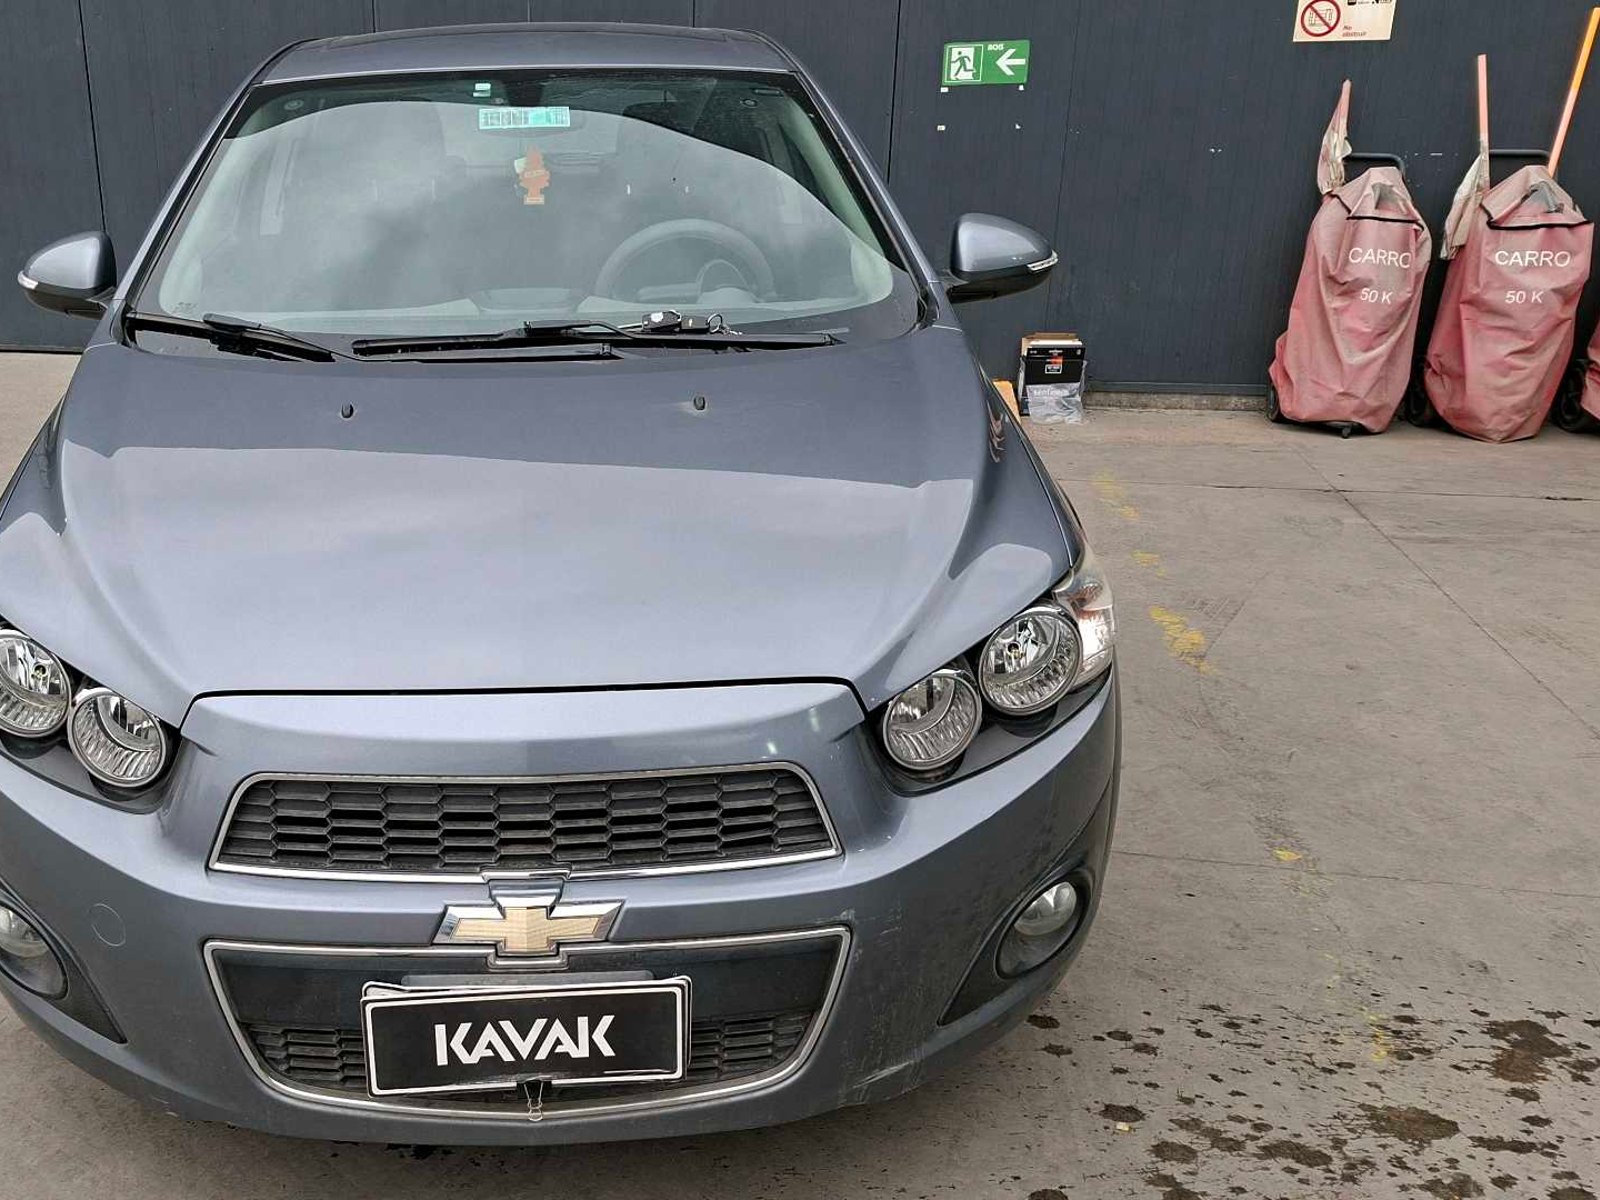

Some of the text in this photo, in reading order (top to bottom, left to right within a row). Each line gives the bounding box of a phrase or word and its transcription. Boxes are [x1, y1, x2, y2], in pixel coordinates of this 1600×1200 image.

[1348, 247, 1412, 269] CARRO
[1495, 250, 1571, 267] CARRO
[1360, 287, 1393, 304] 50 K
[1505, 290, 1544, 304] 50 K
[434, 1015, 616, 1066] KAVAK
